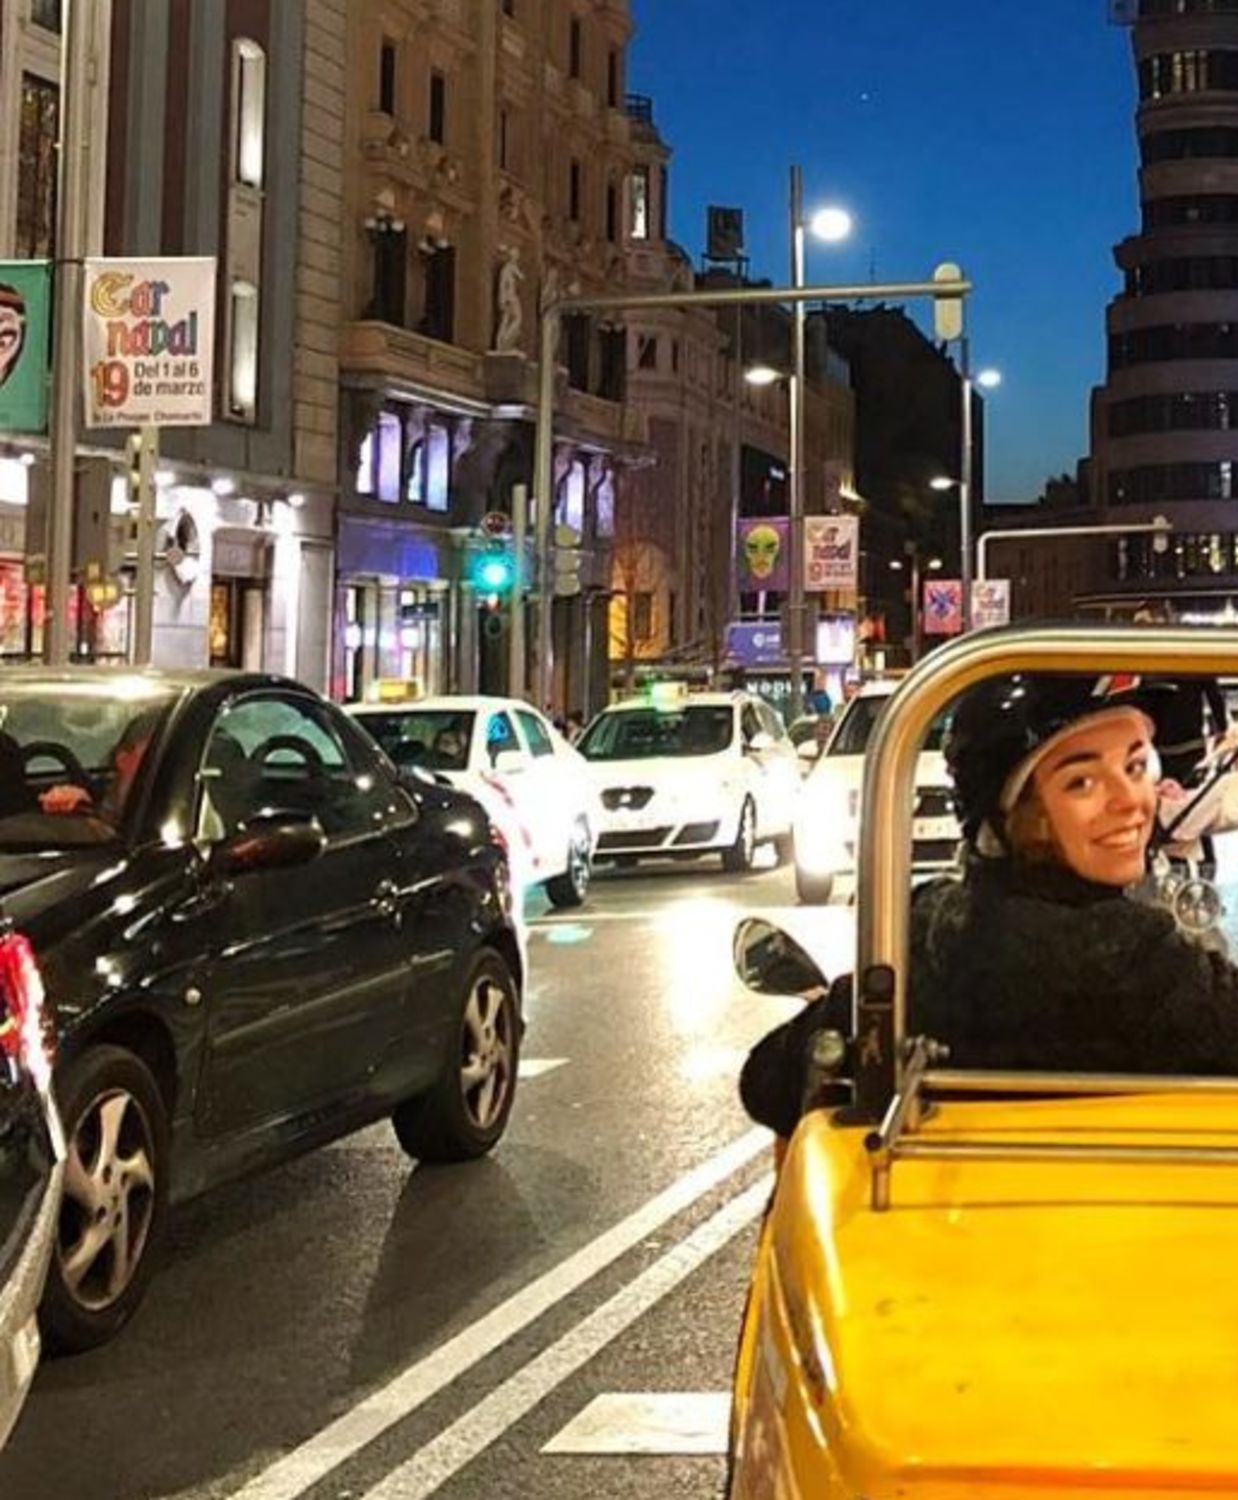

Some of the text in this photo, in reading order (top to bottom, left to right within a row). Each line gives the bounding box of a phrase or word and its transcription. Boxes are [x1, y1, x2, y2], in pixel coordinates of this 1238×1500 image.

[90, 272, 170, 317] Car
[107, 310, 197, 357] naval
[91, 360, 130, 407] 19
[133, 381, 152, 396] de
[134, 362, 160, 378] Del
[172, 362, 186, 378] al
[189, 362, 199, 377] 6
